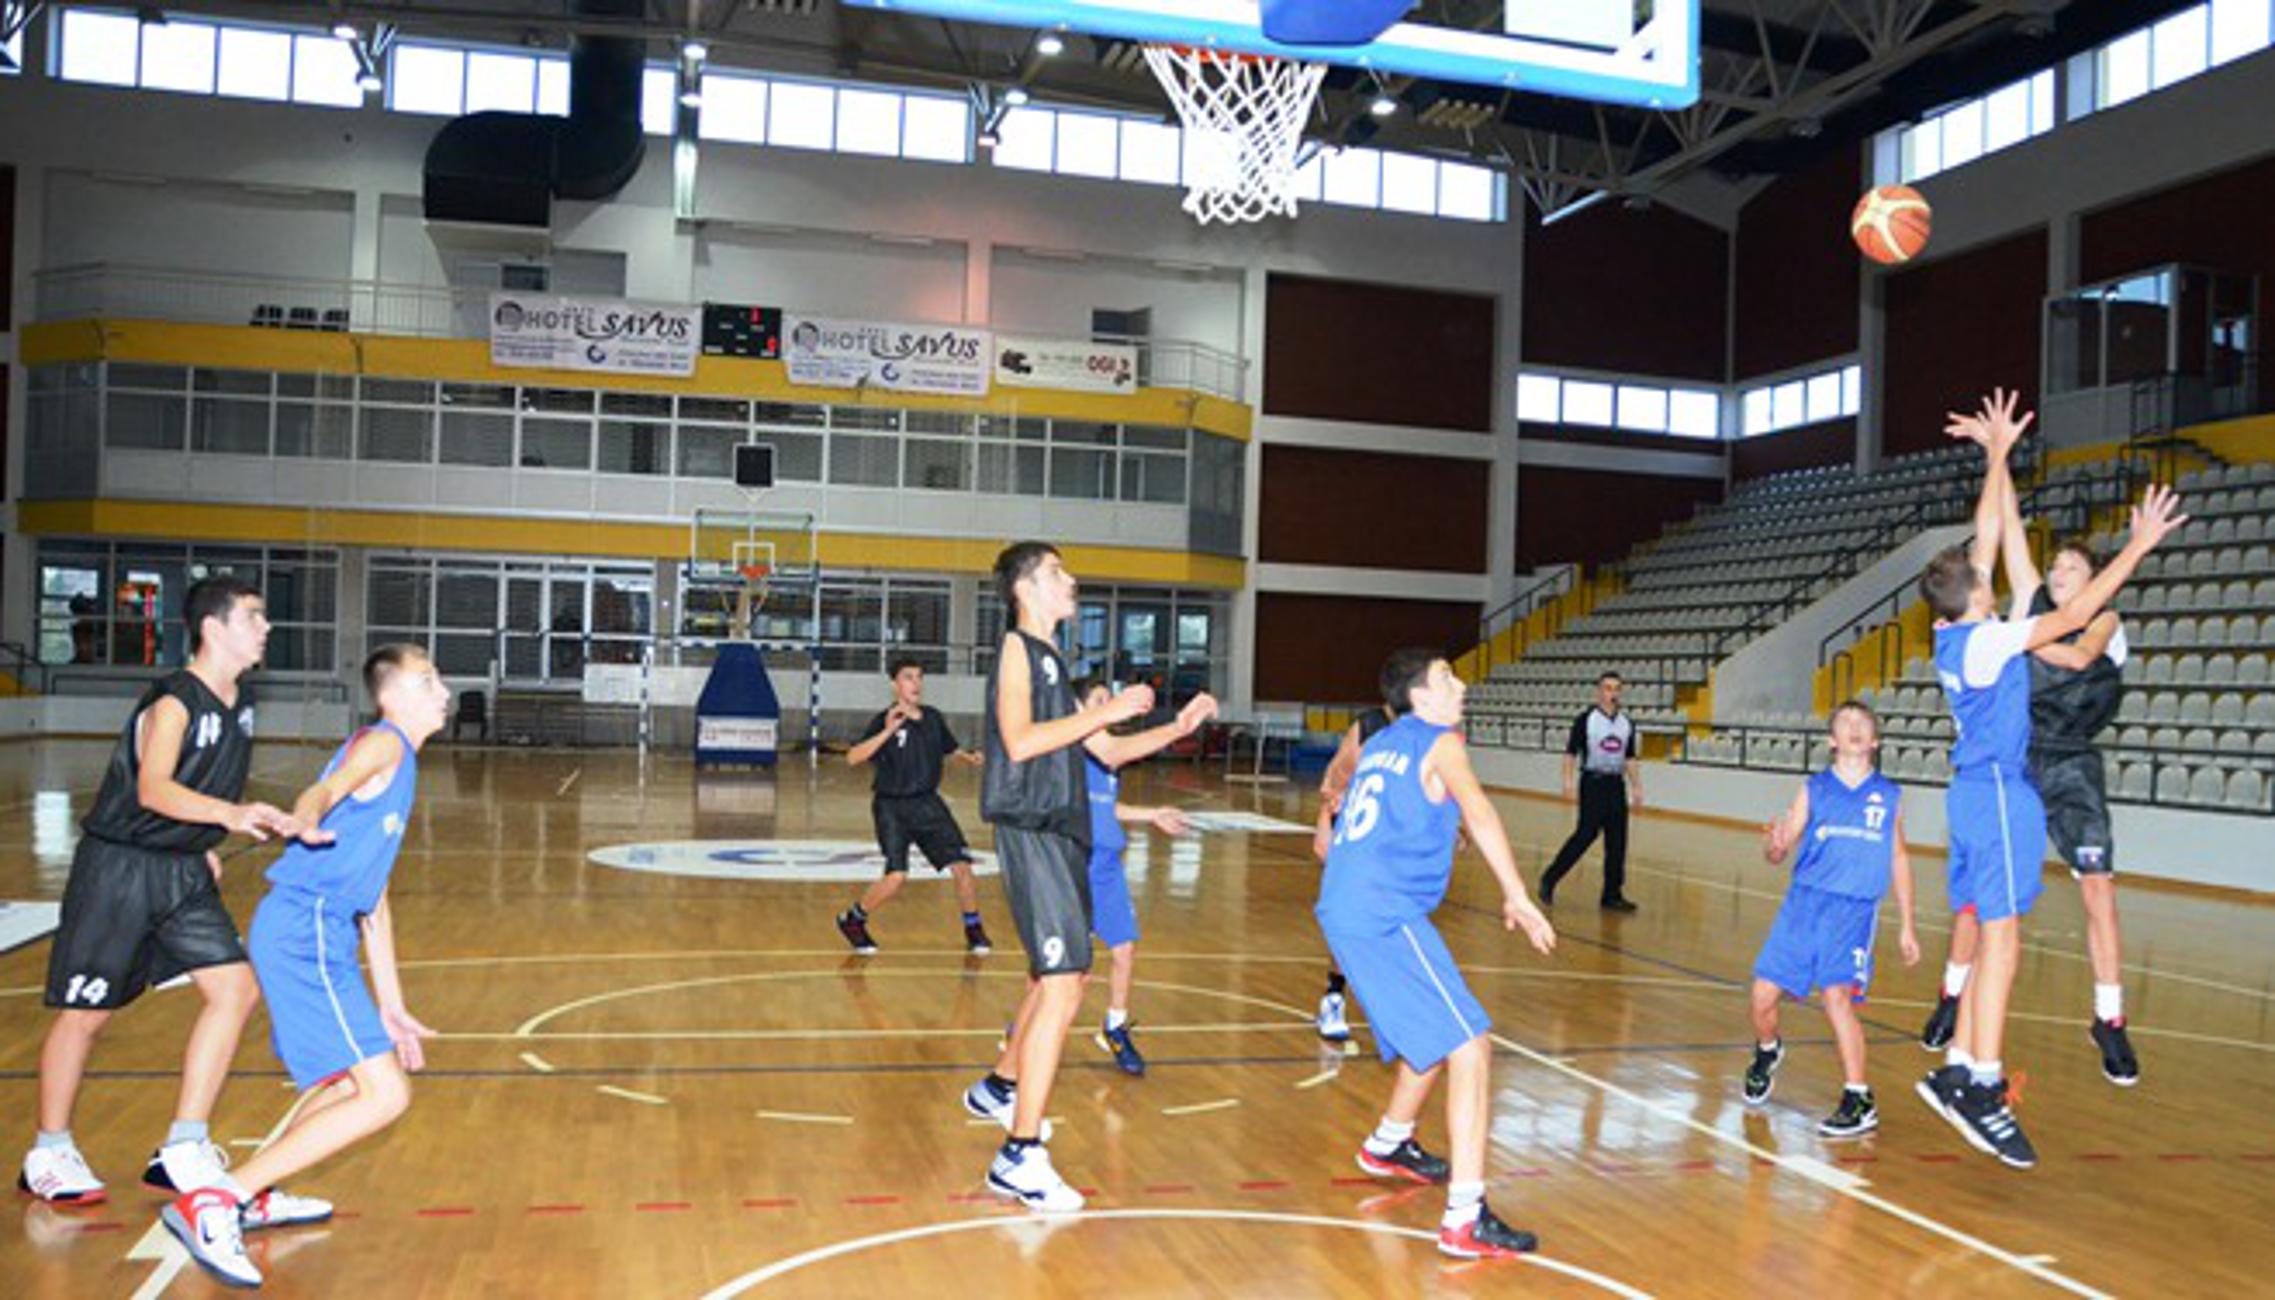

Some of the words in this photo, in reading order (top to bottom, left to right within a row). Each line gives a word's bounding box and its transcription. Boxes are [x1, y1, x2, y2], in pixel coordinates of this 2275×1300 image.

[525, 310, 597, 333] HOTEL
[601, 311, 691, 339] SAVUS
[822, 331, 890, 353] HOTEL
[894, 332, 980, 360] SAVUS
[1042, 655, 1058, 685] 9
[1864, 805, 1887, 829] 17
[1043, 936, 1064, 968] 9
[65, 974, 109, 1004] 14
